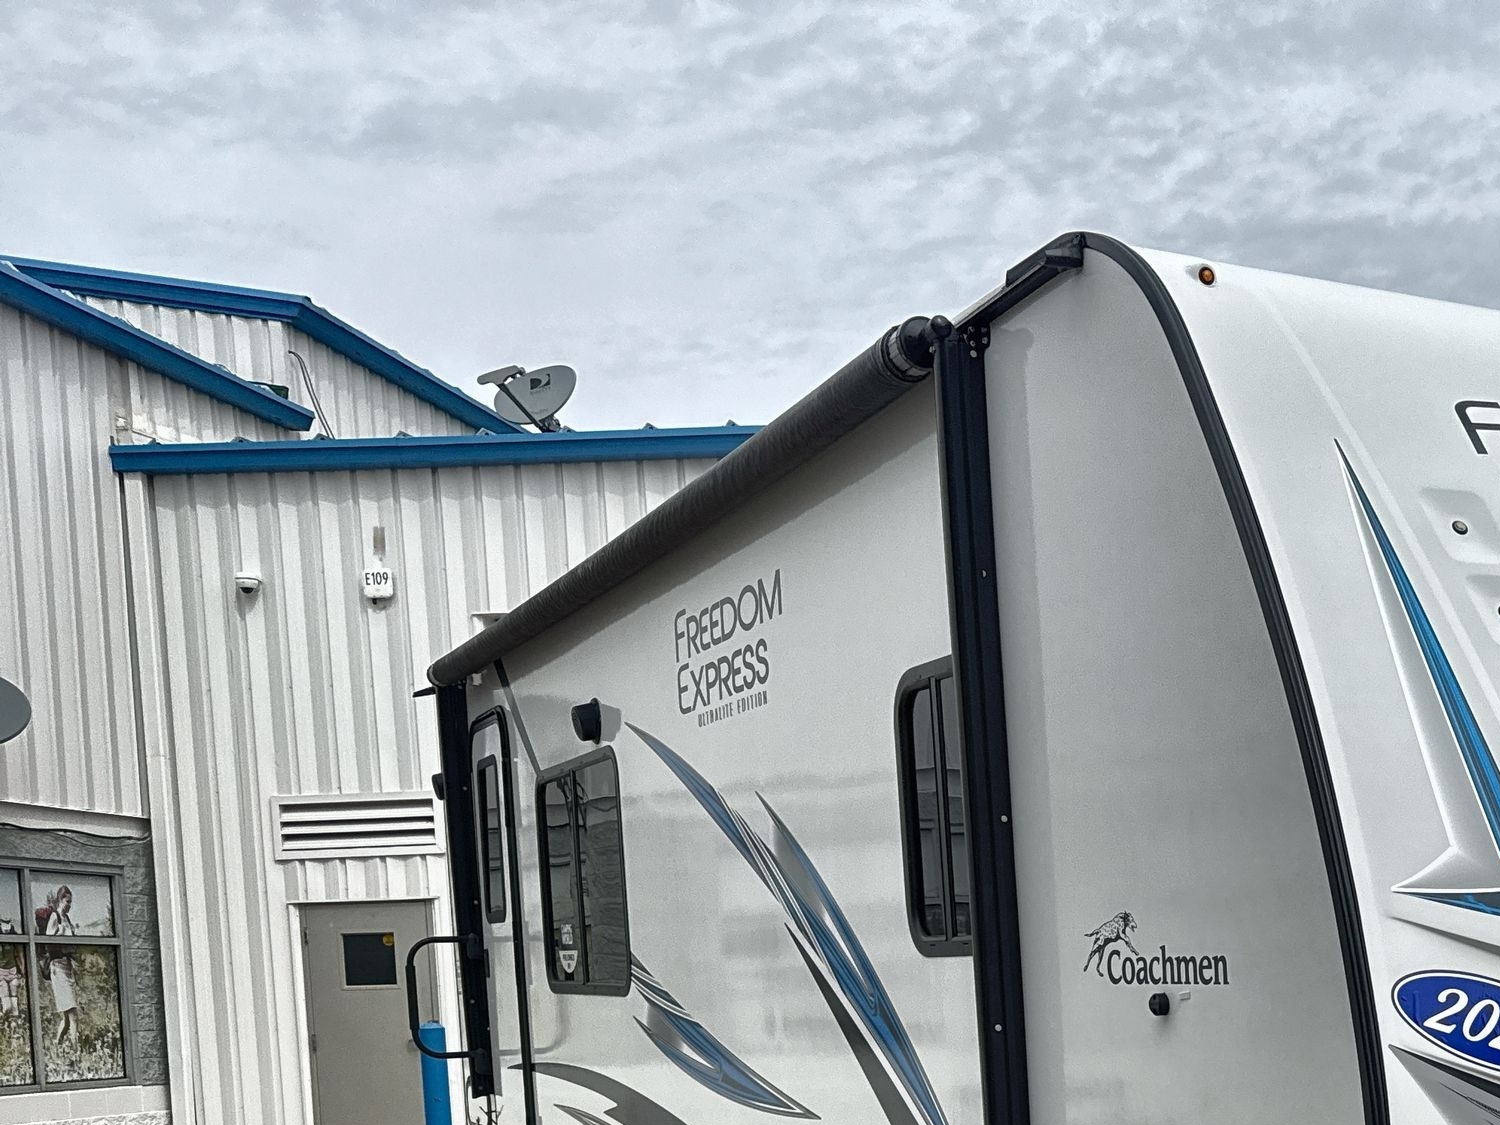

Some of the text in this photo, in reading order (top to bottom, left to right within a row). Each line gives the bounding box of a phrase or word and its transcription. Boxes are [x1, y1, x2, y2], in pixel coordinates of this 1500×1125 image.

[364, 571, 389, 586] E109
[674, 568, 783, 663] FREEDOM
[678, 638, 770, 715] EXPRESS
[698, 690, 768, 728] ULTRALITE EDITION
[1106, 945, 1230, 986] Coachmen
